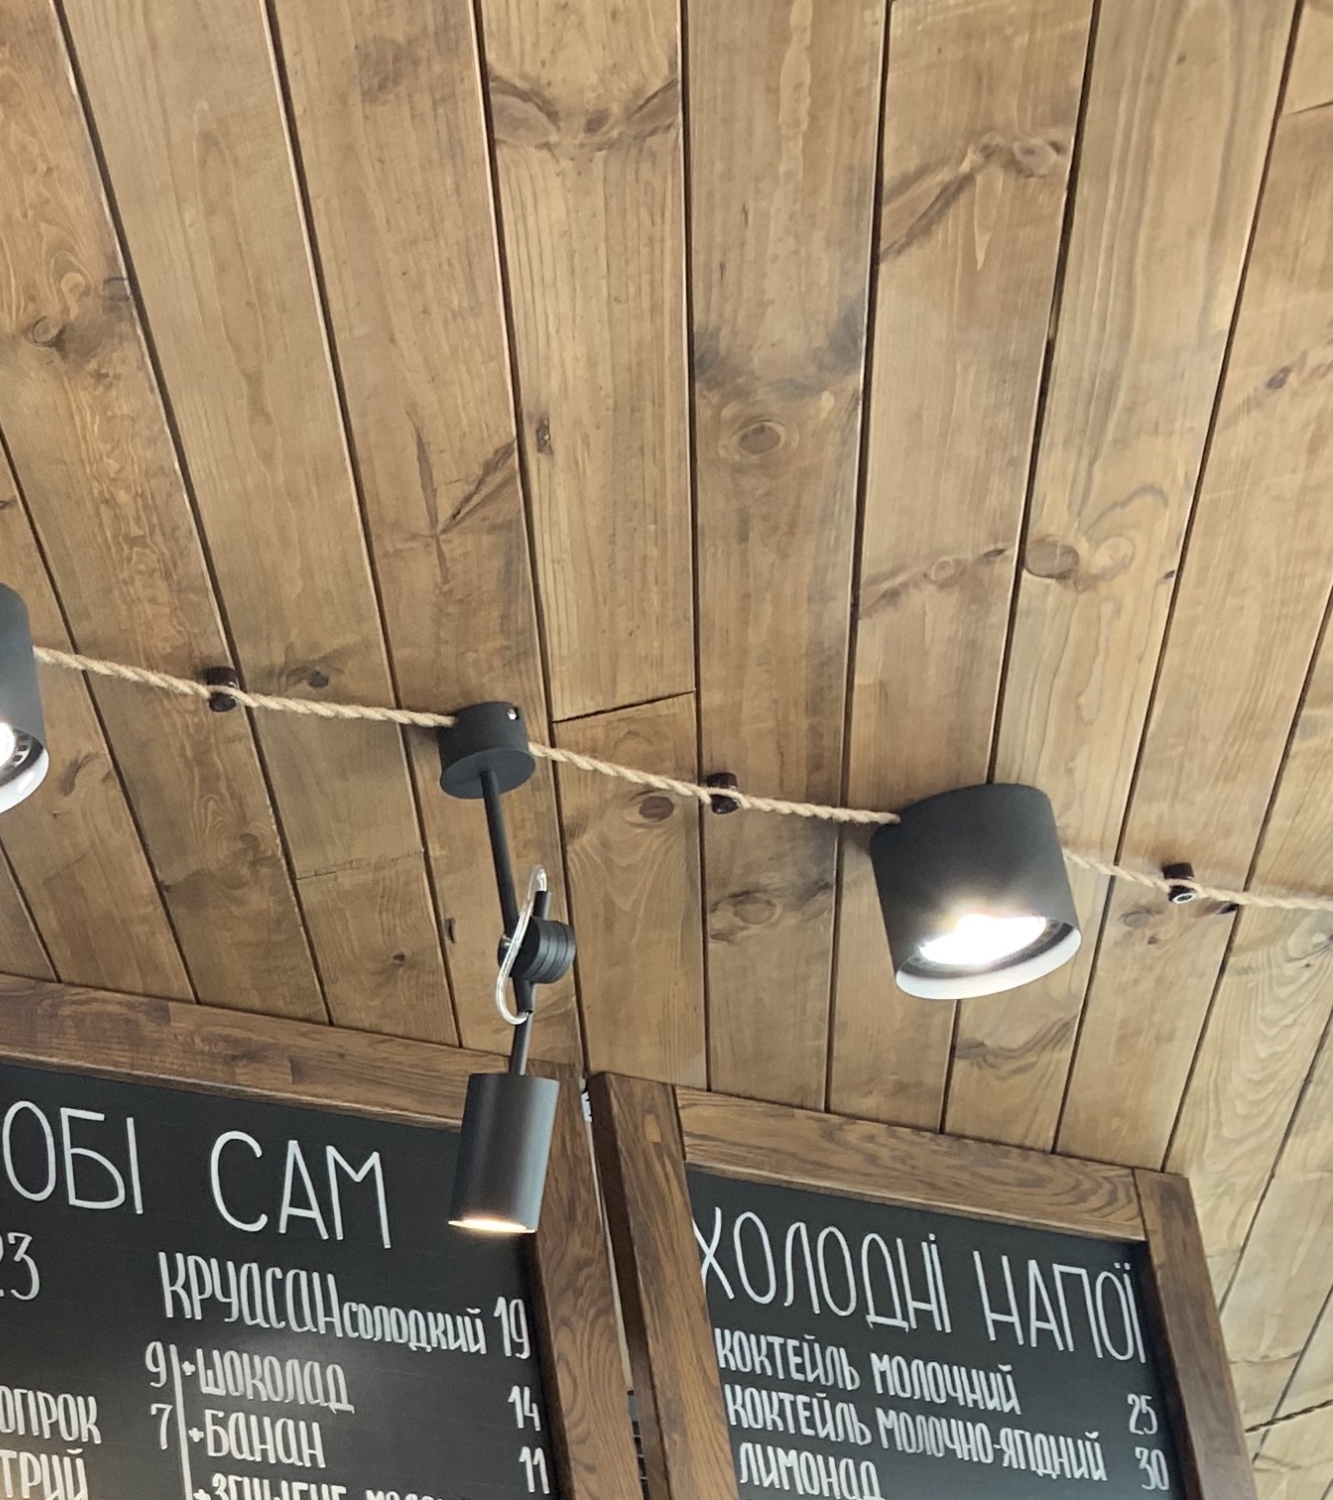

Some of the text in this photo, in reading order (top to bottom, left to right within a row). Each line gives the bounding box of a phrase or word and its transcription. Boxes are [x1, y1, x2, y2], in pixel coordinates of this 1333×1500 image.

[210, 1129, 392, 1250] САМ
[692, 1206, 1147, 1364] ХОЛОДНІ НАПОЇ
[492, 1296, 531, 1360] 19
[144, 1340, 168, 1388] 9
[714, 1326, 1159, 1436] КОКТЕЙЛЬ МОЛОЧНИЙ 25
[150, 1402, 173, 1450] 7
[507, 1385, 542, 1432] 14
[723, 1383, 873, 1448] КОКТЕЙЛЬ
[1133, 1446, 1170, 1492] 30
[518, 1446, 551, 1495] 11
